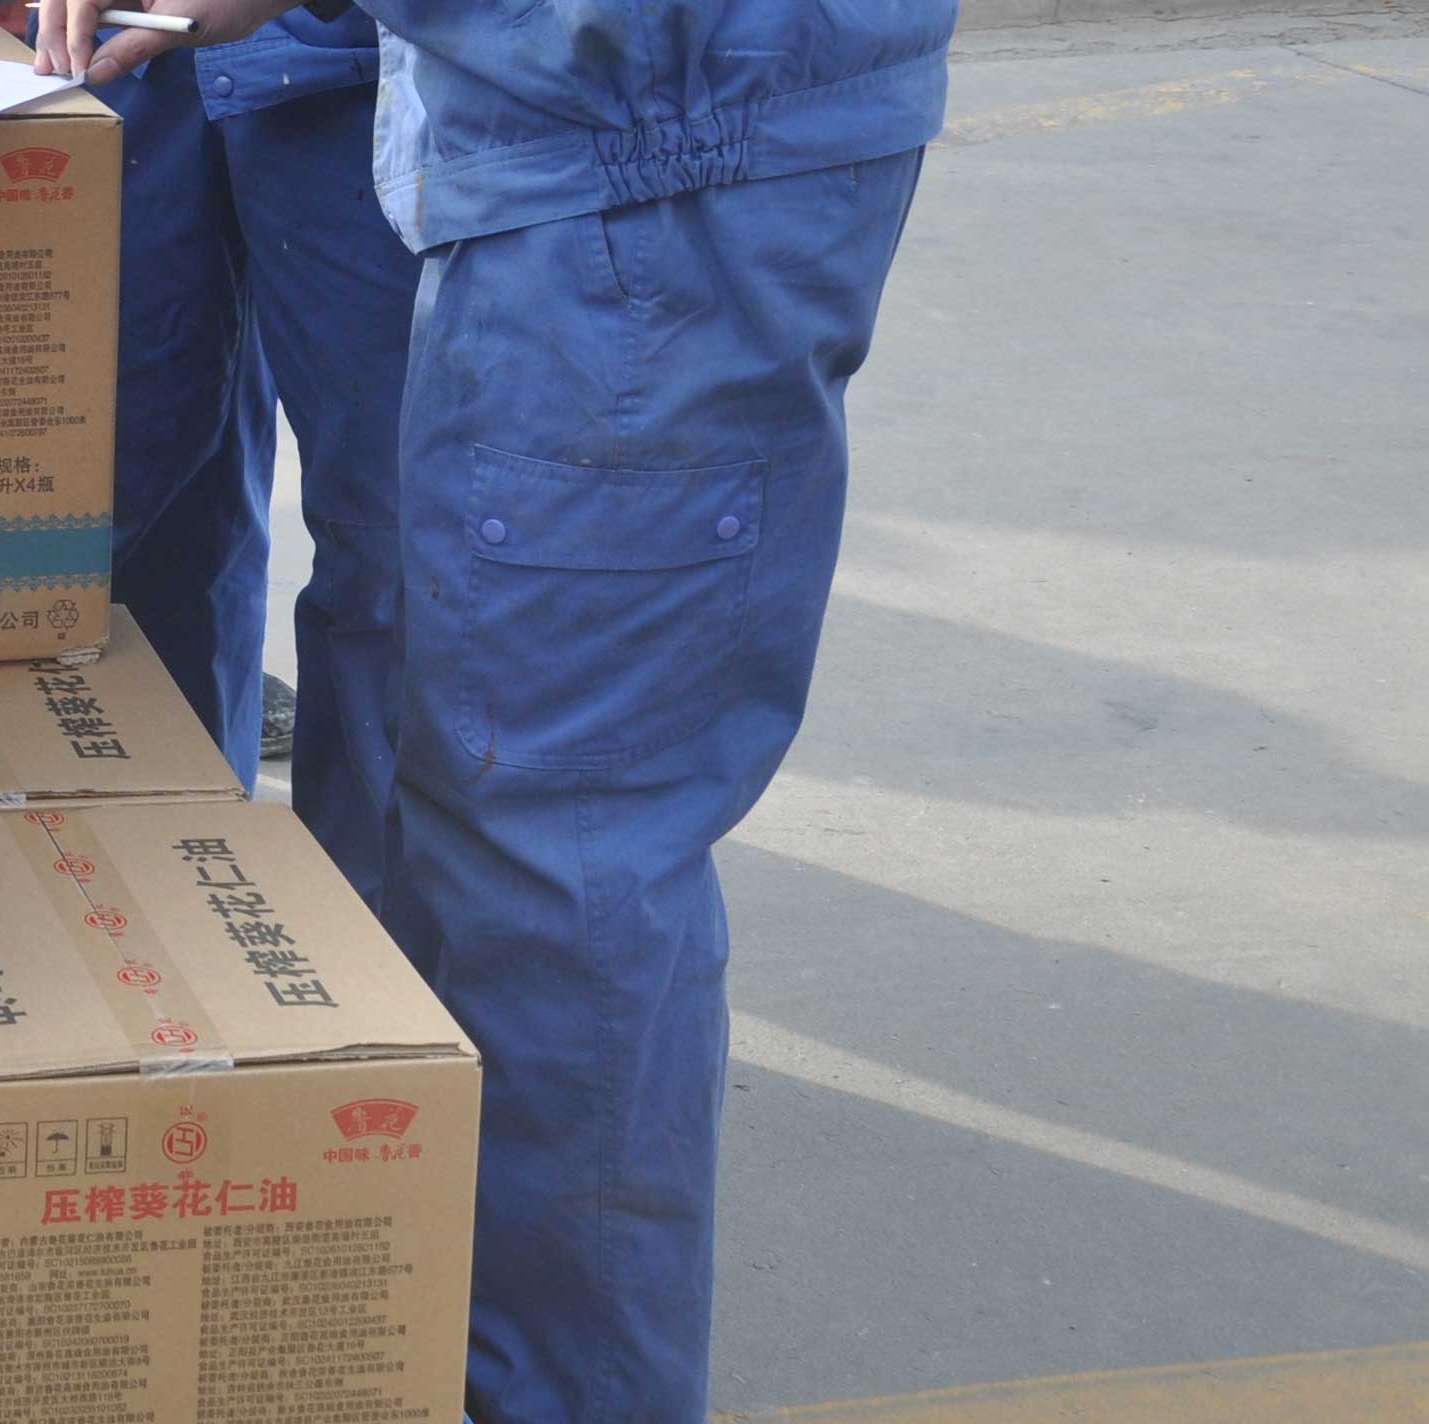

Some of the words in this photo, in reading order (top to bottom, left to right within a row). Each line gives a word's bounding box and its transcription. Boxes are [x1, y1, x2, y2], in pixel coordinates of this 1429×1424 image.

[172, 837, 340, 1009] 压榨葵花仁油
[41, 1177, 299, 1226] 压榨葵花仁油
